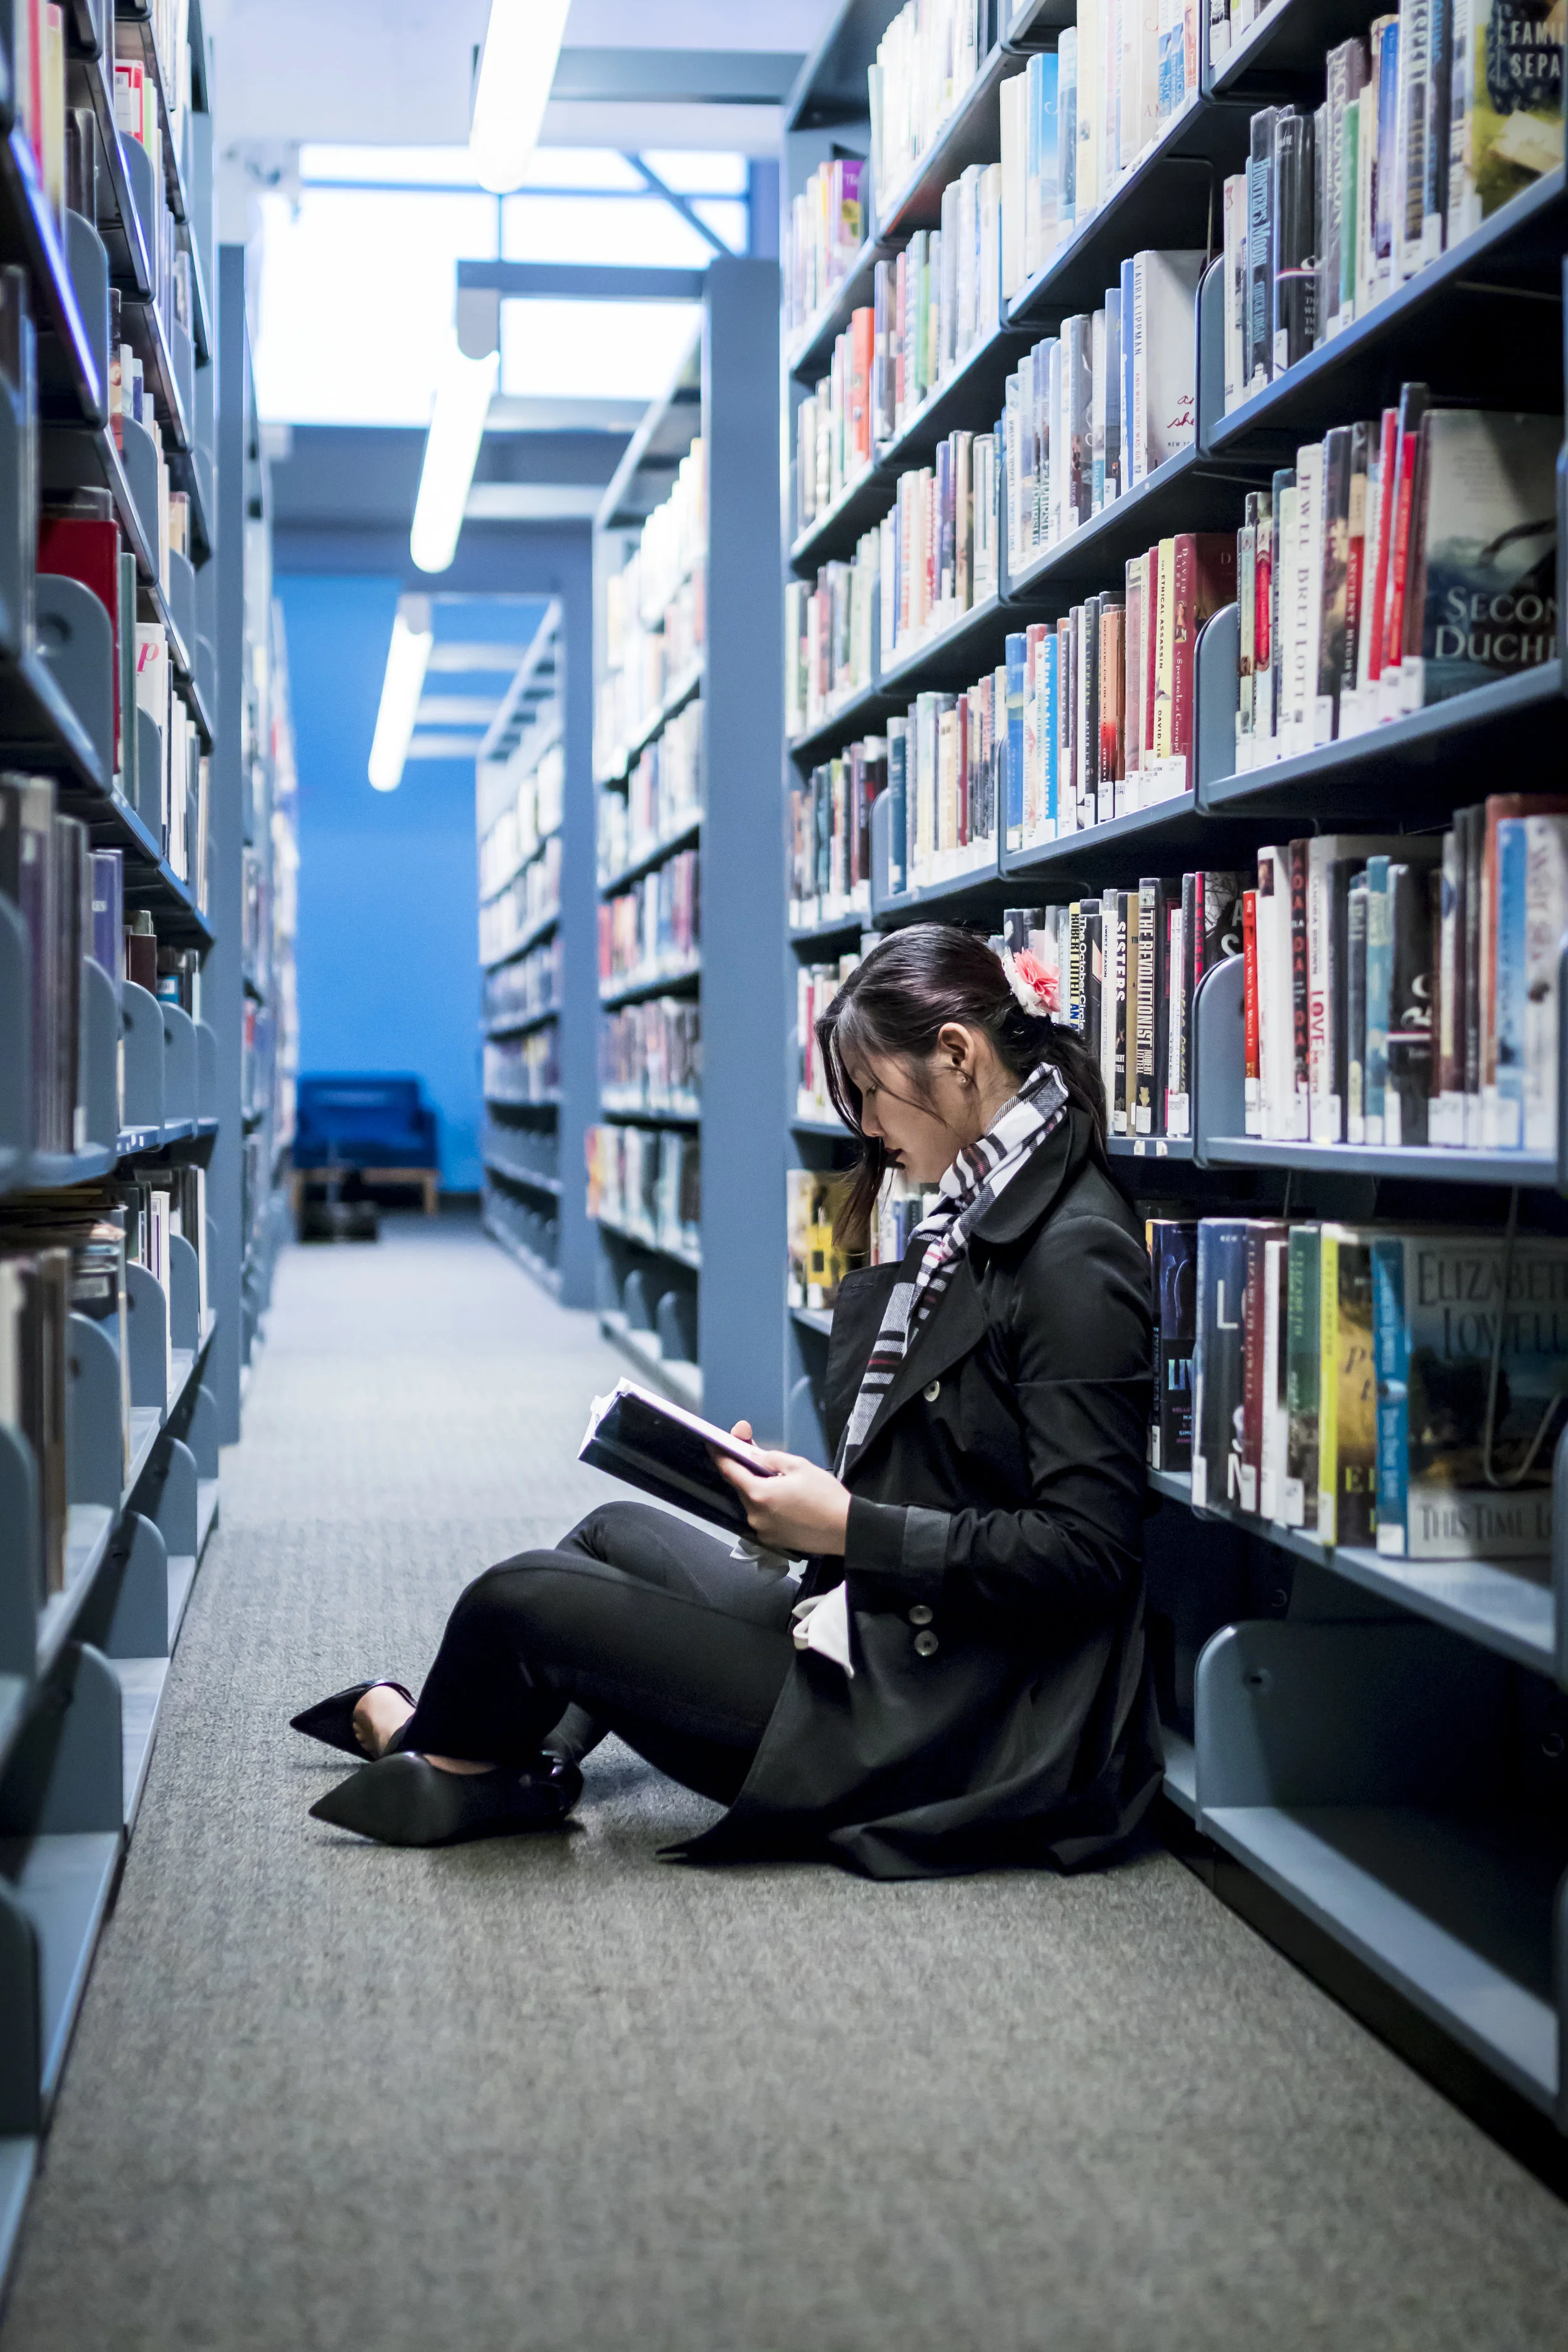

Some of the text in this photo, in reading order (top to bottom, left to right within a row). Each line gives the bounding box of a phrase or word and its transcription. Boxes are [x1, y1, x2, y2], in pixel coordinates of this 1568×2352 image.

[1511, 21, 1565, 46] FAMIL
[1510, 53, 1561, 78] SEPA
[1175, 82, 1184, 104] CHO
[1252, 220, 1271, 268] MOON
[1134, 265, 1142, 300] LAURA
[1134, 305, 1142, 356] LIPPMAN
[1180, 548, 1189, 593] DAVID
[1294, 474, 1311, 700] JEWEL BRET LOTT
[1346, 551, 1357, 623] ANCIENT
[1175, 658, 1184, 704] Spectacle
[1173, 712, 1182, 756] Corrupt
[1079, 916, 1088, 941] The
[1079, 942, 1087, 994] October
[1115, 921, 1126, 1002] SISTERS
[1136, 909, 1153, 1048] THE REVOLUTIONIST
[1069, 1002, 1079, 1020] AN
[1311, 990, 1325, 1046] LOVE
[1136, 1049, 1144, 1074] LITTELL
[1143, 1049, 1153, 1076] ROBERT
